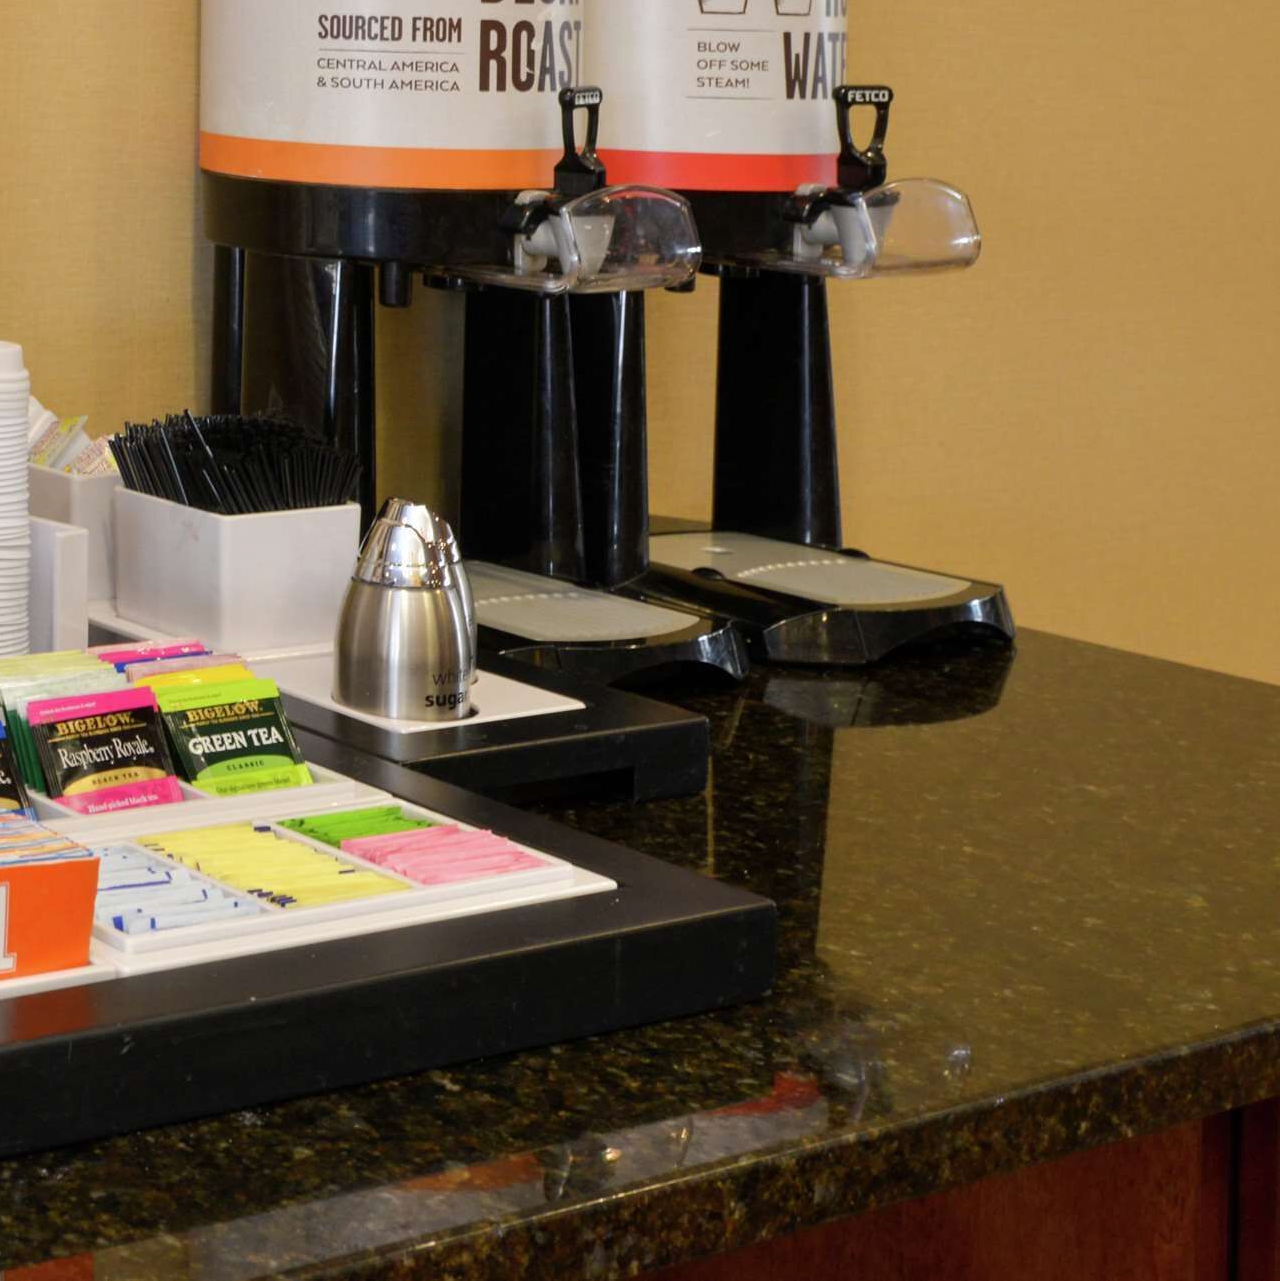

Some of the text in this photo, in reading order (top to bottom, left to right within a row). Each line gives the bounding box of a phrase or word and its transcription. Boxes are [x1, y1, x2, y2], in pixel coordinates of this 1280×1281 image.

[317, 13, 462, 44] SOURCED FROM
[478, 18, 582, 93] ROAST
[696, 41, 741, 53] BLOW
[316, 57, 460, 74] CENTRAL AMERICA
[696, 59, 770, 73] OFF SOME
[316, 76, 461, 93] & SOUTH AMERICA
[696, 76, 751, 89] STEAM!
[846, 89, 890, 103] FETCO
[184, 700, 261, 723] BIGELOW
[55, 711, 133, 737] BIGELOW
[187, 725, 285, 756] GREEN TEA
[57, 734, 152, 771] Raspberry Royale
[226, 759, 266, 772] CLASSIC
